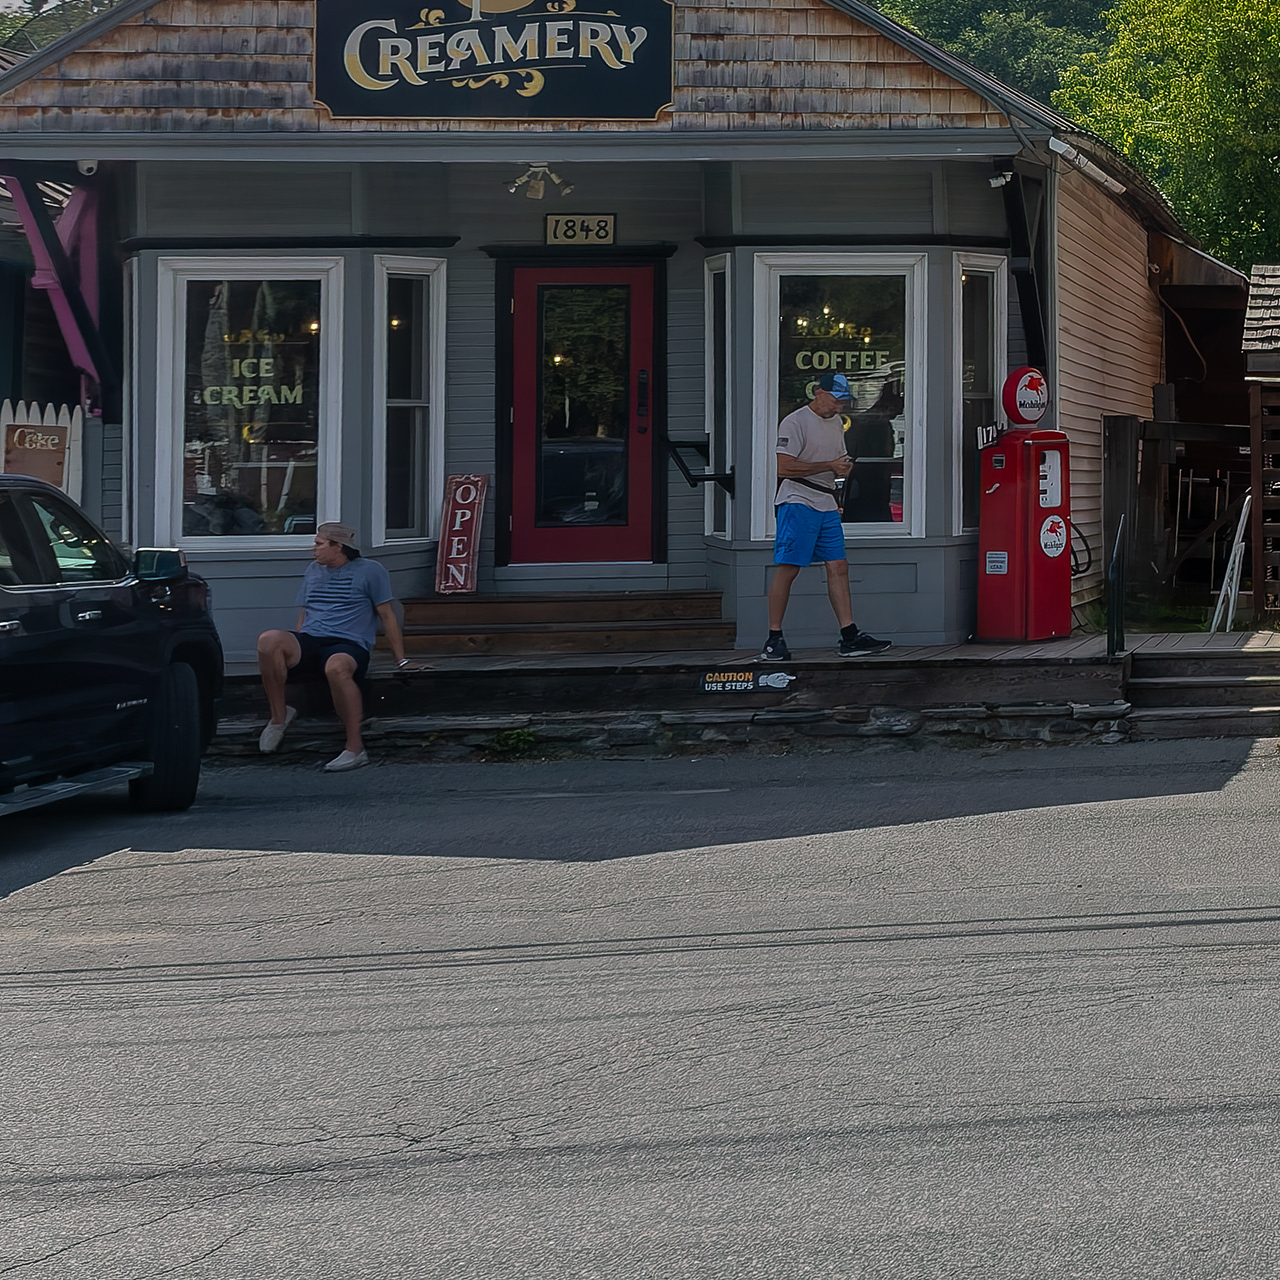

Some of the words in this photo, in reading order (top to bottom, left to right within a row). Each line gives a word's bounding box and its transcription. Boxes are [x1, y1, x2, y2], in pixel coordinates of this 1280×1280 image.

[344, 19, 648, 91] CREAMERY
[553, 219, 609, 240] 1848
[232, 358, 275, 378] ICE
[203, 385, 303, 409] CREAM
[446, 484, 477, 586] OPEN
[705, 683, 723, 691] USE
[725, 682, 754, 690] STEPS
[706, 672, 753, 682] CAUTION
